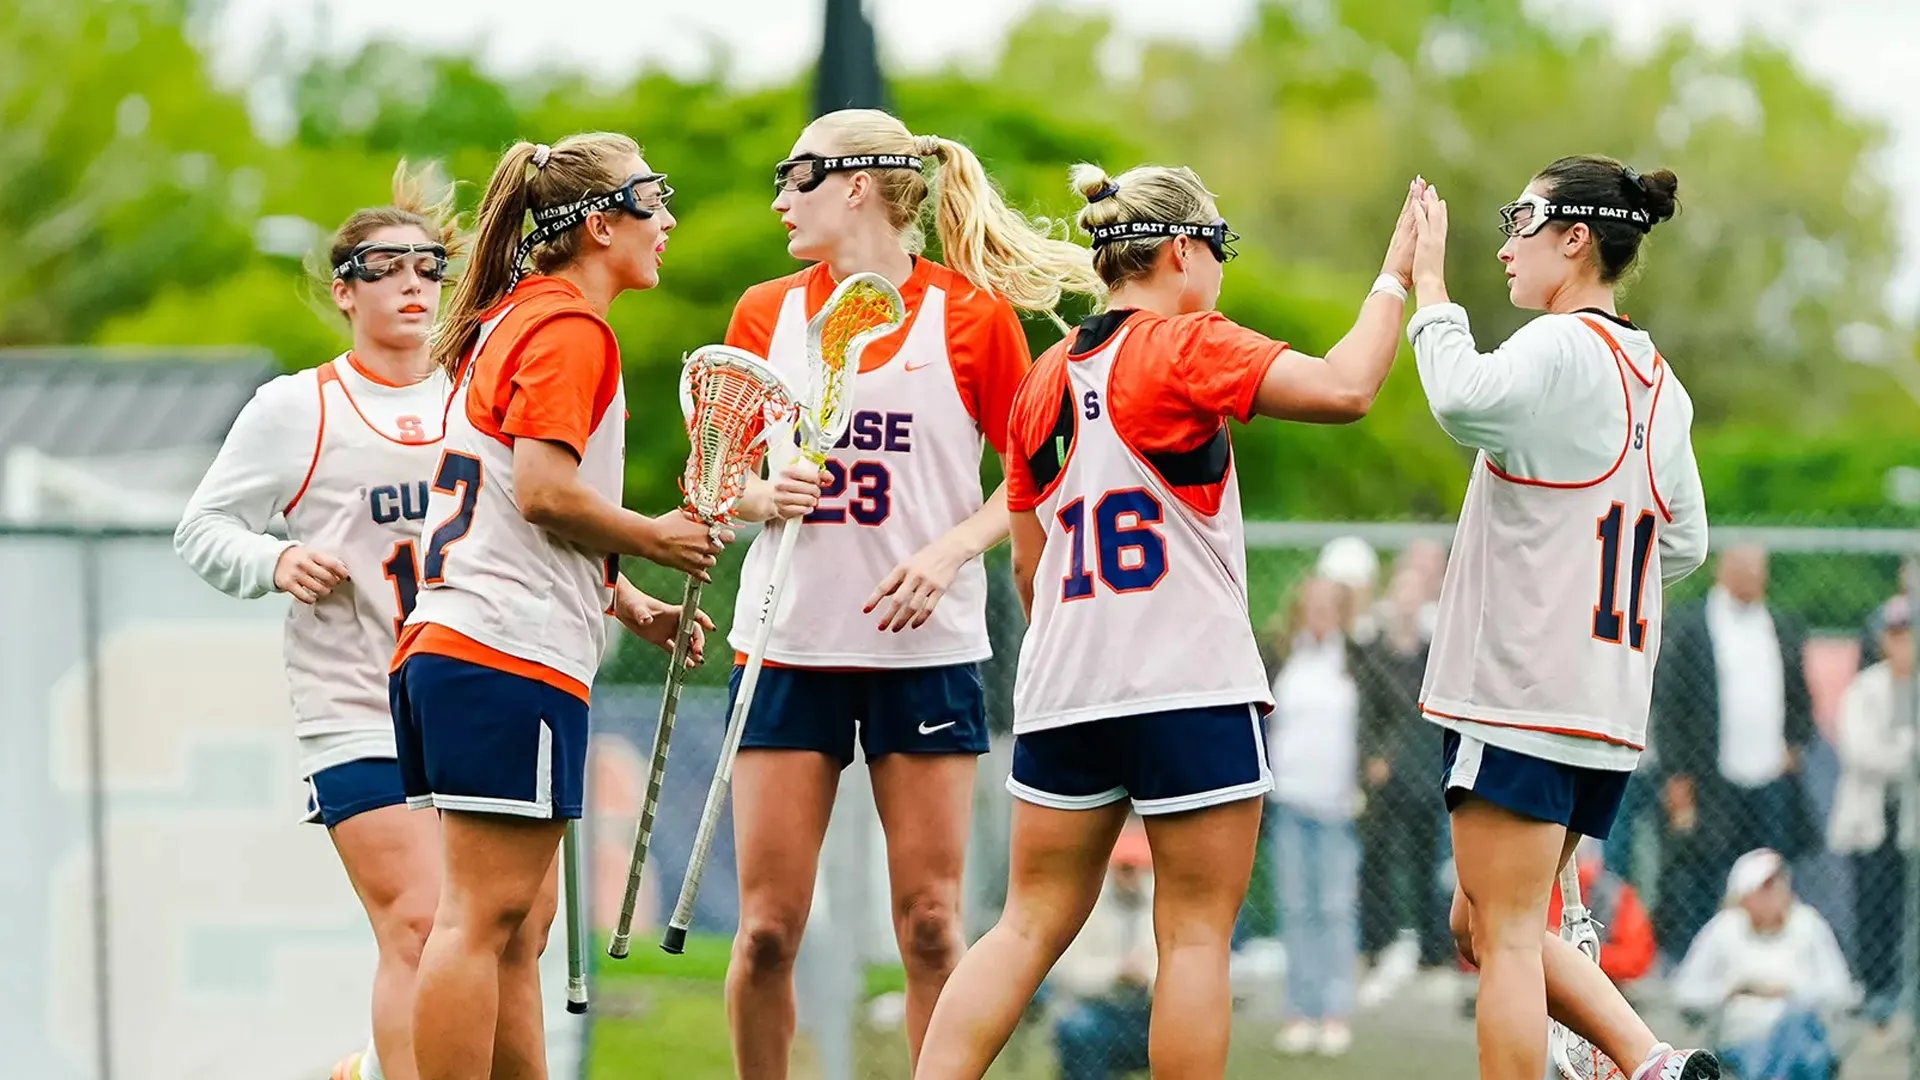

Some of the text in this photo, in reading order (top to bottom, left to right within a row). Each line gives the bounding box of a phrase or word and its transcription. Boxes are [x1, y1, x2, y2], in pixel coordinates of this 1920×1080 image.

[842, 156, 875, 167] GAIT
[878, 155, 907, 166] GAIT
[552, 212, 577, 231] GAIT
[580, 196, 610, 217] GAIT
[1562, 205, 1595, 215] GAIT
[1599, 207, 1629, 218] GAIT
[1132, 222, 1165, 232] GAIT
[1169, 224, 1198, 235] GAIT
[1084, 391, 1100, 421] S
[396, 415, 425, 441] S
[1633, 422, 1645, 450] S
[802, 457, 891, 526] 23
[1056, 486, 1169, 603] 16
